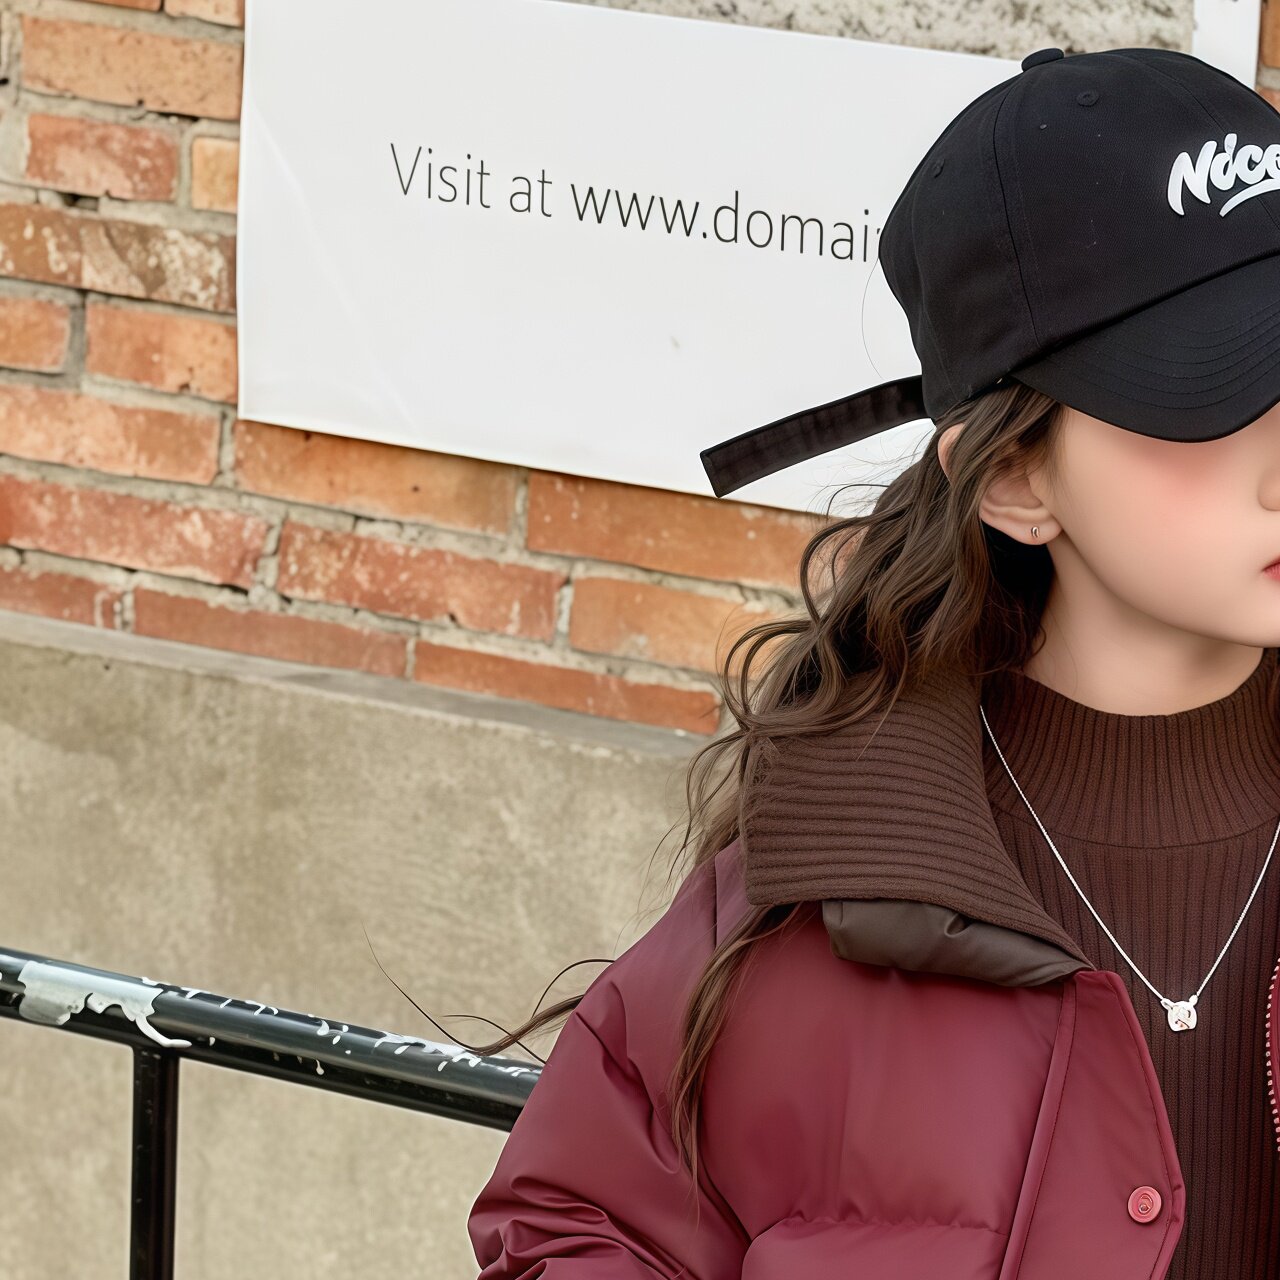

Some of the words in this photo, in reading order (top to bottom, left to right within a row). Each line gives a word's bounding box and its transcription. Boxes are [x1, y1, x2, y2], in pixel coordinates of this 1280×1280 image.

[389, 142, 491, 209] Visit
[508, 168, 553, 218] at
[570, 183, 881, 263] www.domai
